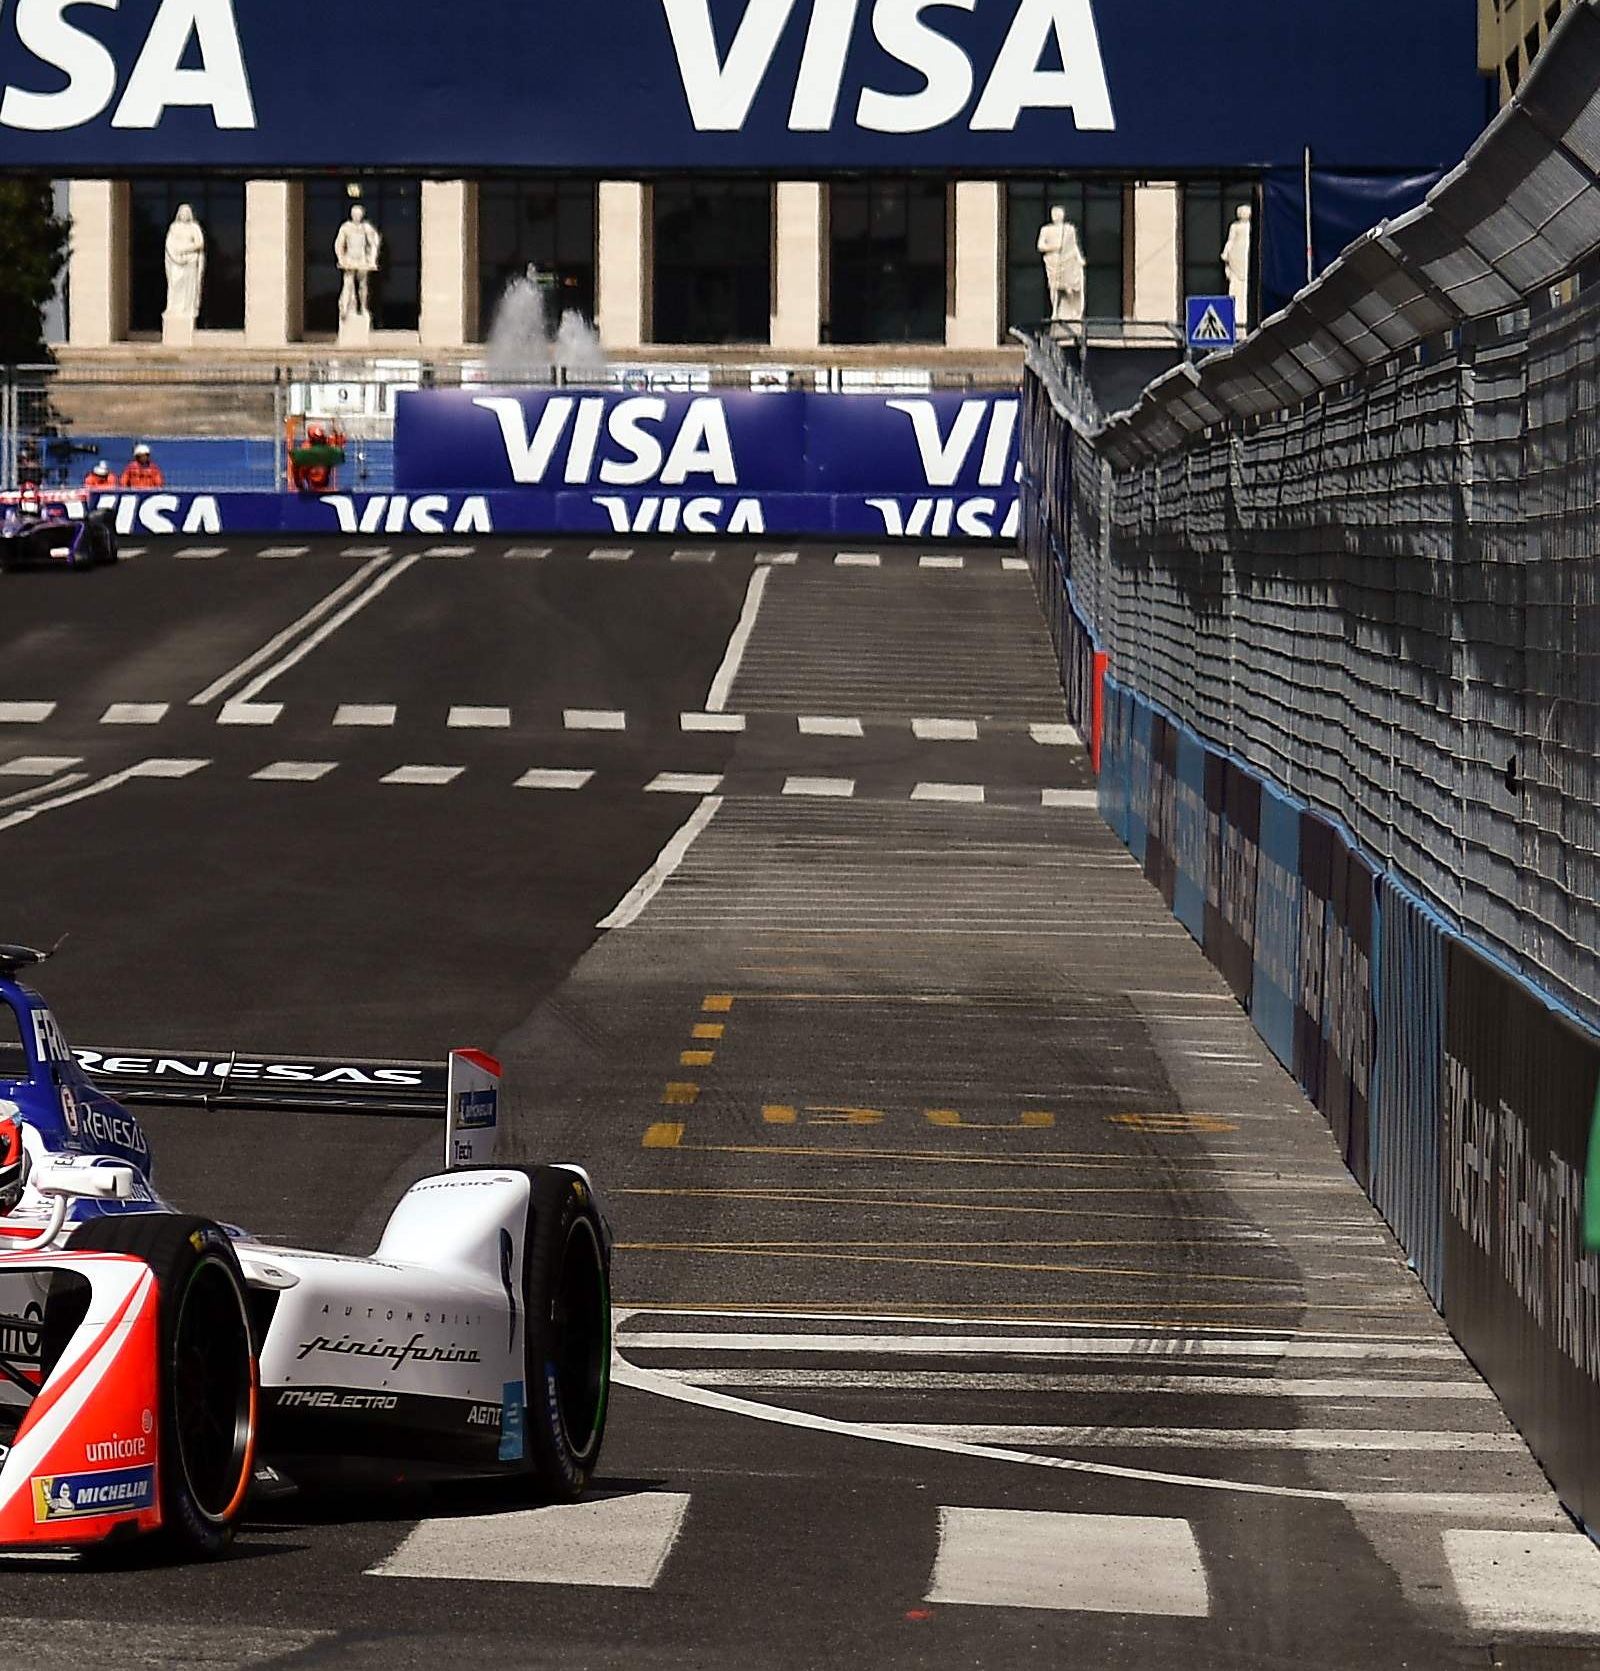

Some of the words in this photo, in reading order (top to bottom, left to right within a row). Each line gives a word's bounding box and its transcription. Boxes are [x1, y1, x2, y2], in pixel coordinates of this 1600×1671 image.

[471, 396, 738, 485] VISA
[885, 399, 1023, 486] VI
[319, 494, 492, 534] VISA
[592, 496, 766, 534] VISA
[71, 1049, 422, 1086] RENESAS
[80, 1101, 147, 1155] RENESAS
[321, 1304, 482, 1325] AUTOMOBILI
[296, 1333, 481, 1371] pininfarina
[86, 1432, 146, 1462] umicore
[76, 1480, 148, 1505] MICHELIN
